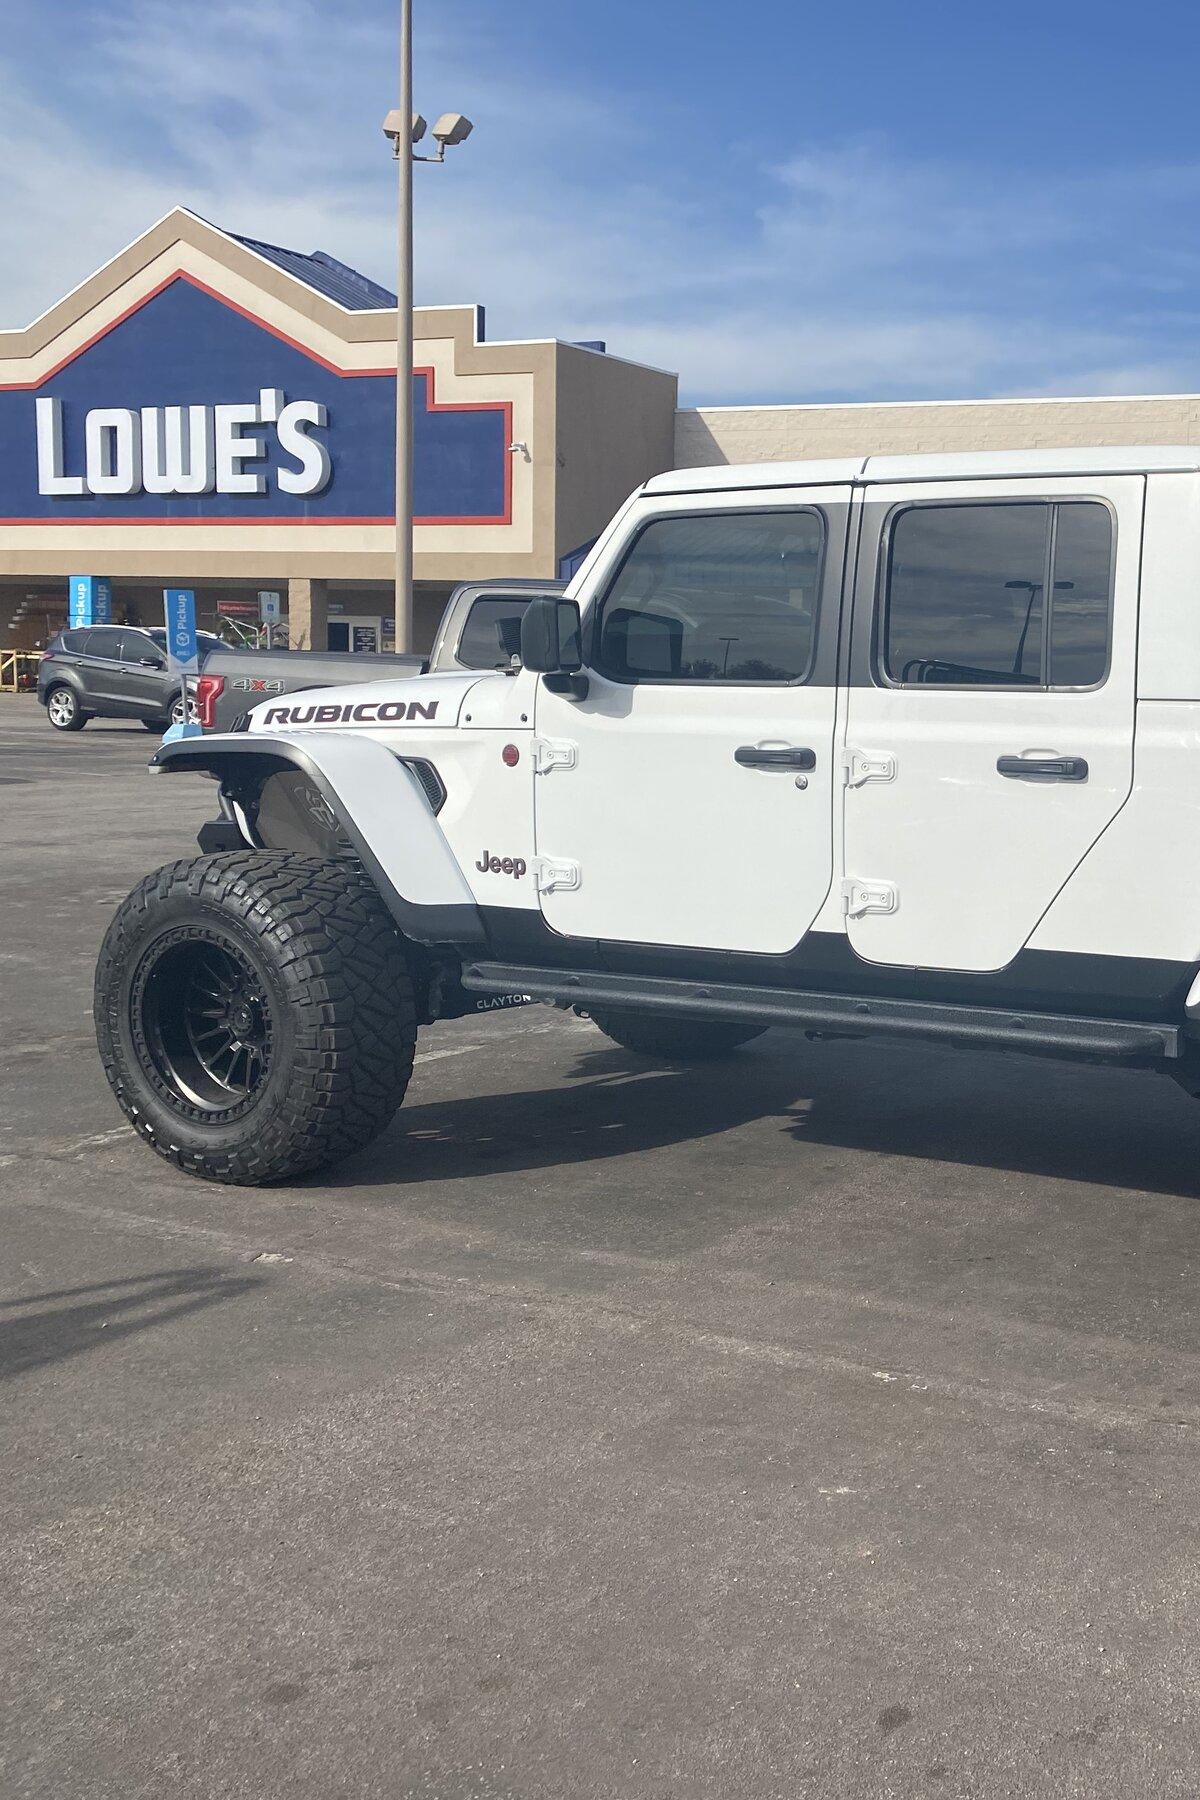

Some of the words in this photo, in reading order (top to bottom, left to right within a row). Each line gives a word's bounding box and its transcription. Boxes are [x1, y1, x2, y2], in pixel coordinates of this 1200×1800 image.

[36, 388, 331, 495] LOWE'S
[75, 583, 88, 628] Pickup
[177, 594, 188, 630] Pickup
[263, 701, 440, 725] RUBICON
[475, 850, 527, 879] Jeep
[476, 994, 532, 1009] CLAYTON
